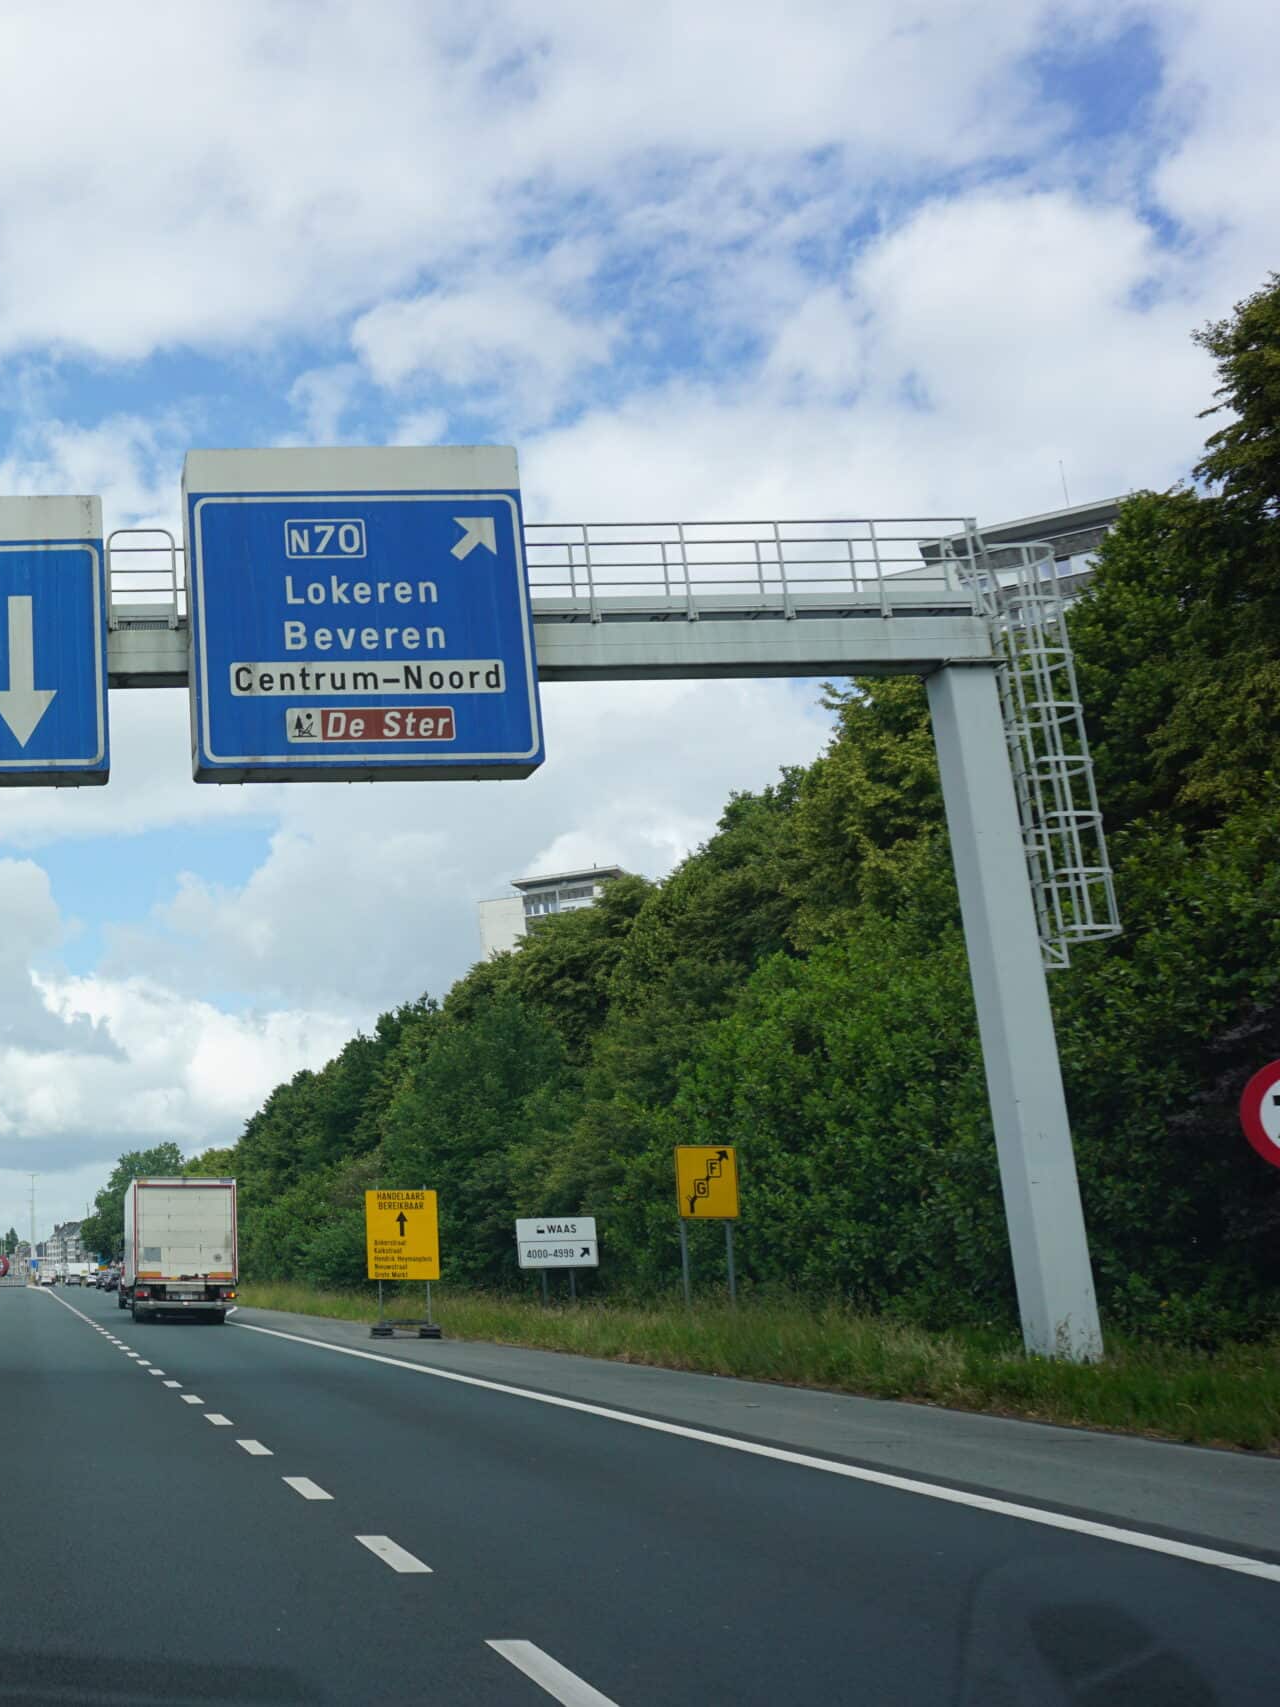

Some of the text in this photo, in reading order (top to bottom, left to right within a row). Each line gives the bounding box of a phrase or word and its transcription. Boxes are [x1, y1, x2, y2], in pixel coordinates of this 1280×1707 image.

[290, 524, 361, 554] N70
[285, 575, 439, 605] Lokeren
[284, 621, 447, 650] Beveren
[234, 663, 502, 692] Centrum-Noord
[326, 710, 451, 738] De Ster
[710, 1162, 718, 1174] F
[697, 1182, 707, 1195] G
[377, 1191, 425, 1201] HANDELAARS
[378, 1201, 425, 1210] BEREIKBAAR
[547, 1224, 577, 1234] WAAS
[527, 1248, 575, 1259] 4000-4999
